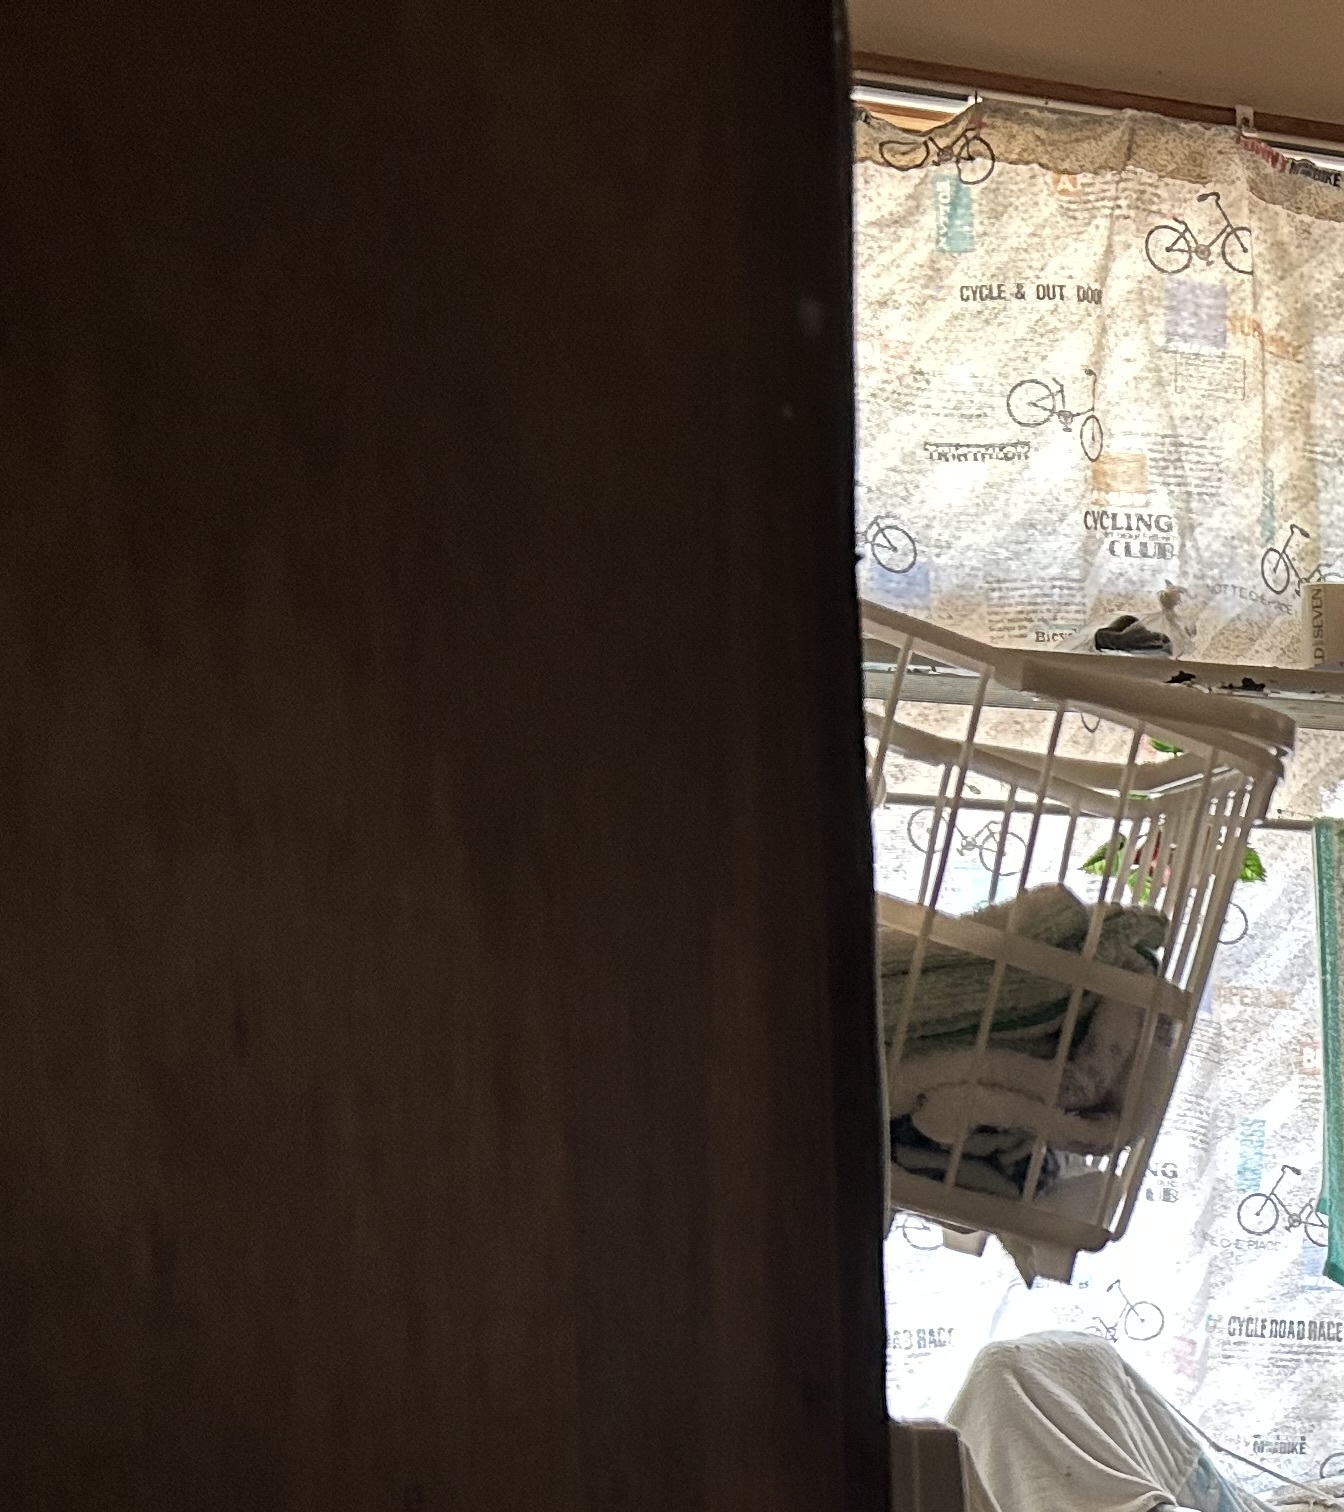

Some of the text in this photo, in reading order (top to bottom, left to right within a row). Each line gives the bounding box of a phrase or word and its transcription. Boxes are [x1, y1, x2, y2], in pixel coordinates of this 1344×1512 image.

[959, 284, 1006, 302] CYCLE
[1036, 284, 1066, 301] OUT
[1083, 510, 1174, 533] CYCLING
[1108, 540, 1177, 560] CLUB
[1311, 588, 1324, 639] SEVEN
[1307, 1320, 1344, 1343] RACE
